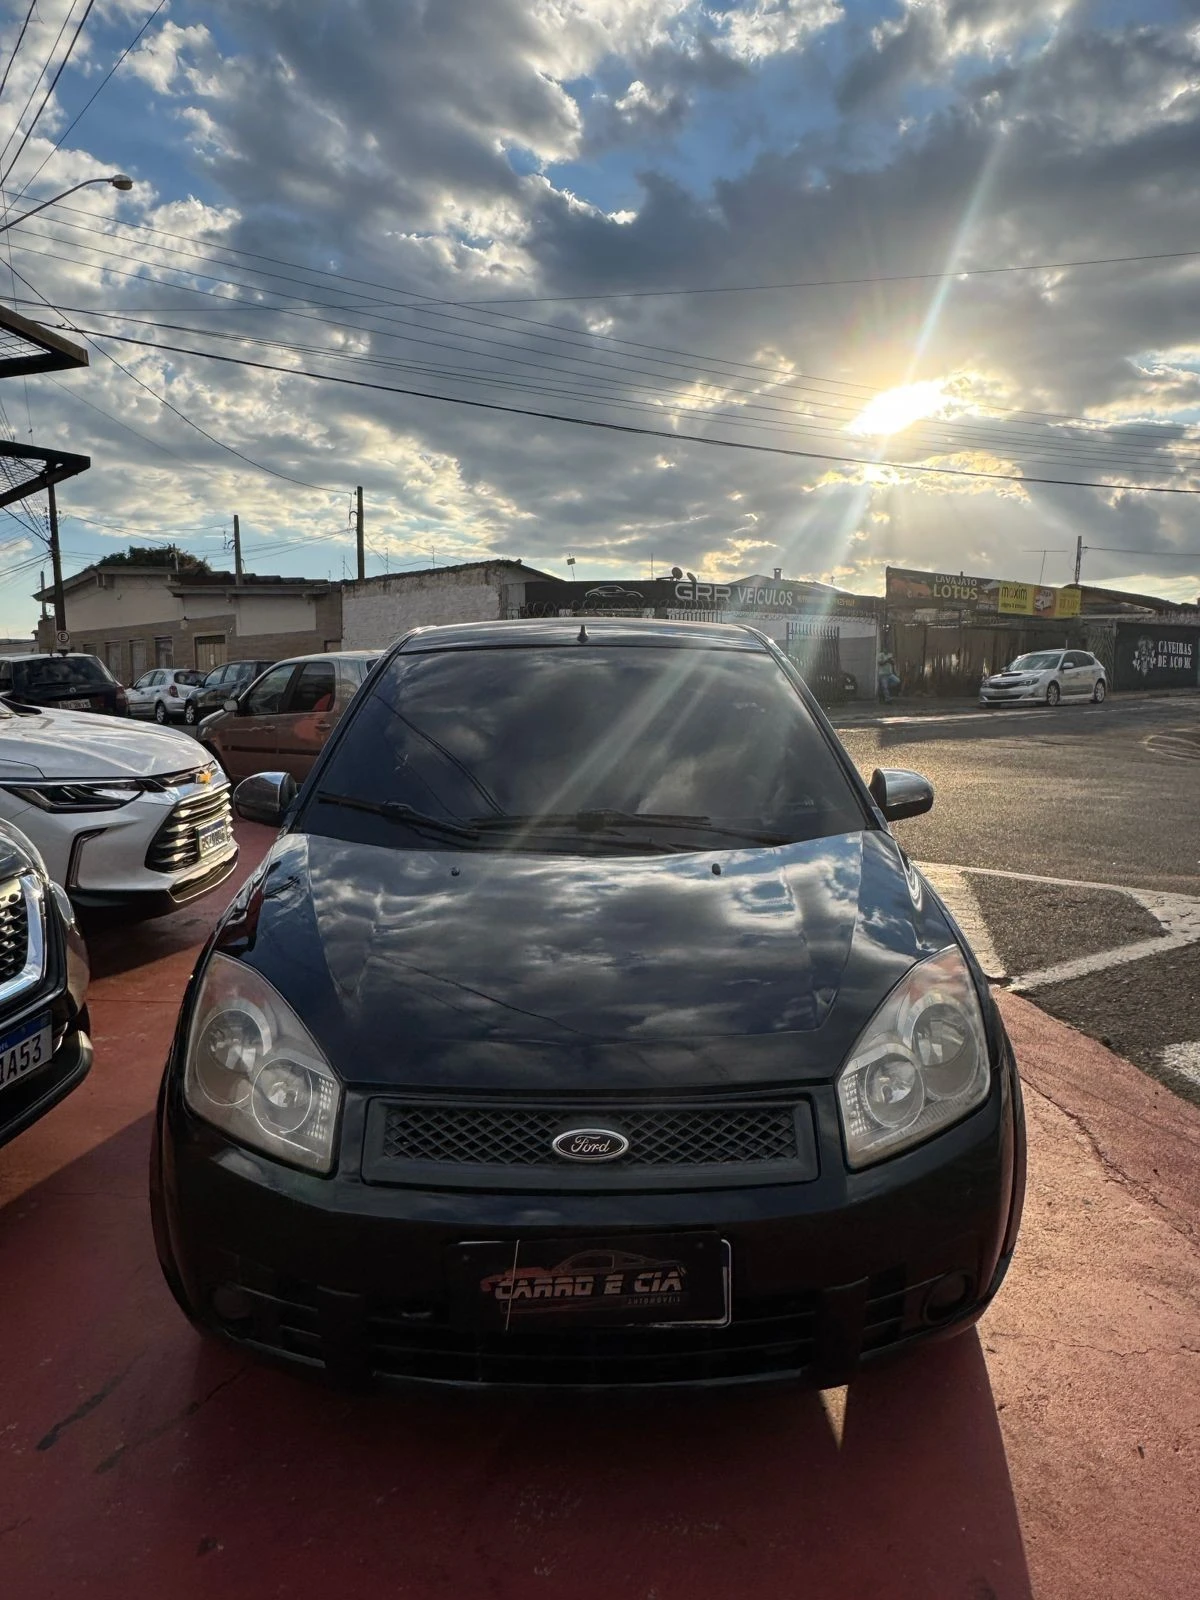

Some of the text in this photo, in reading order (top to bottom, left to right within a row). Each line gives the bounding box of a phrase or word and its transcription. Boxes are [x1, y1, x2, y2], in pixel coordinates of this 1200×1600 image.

[675, 583, 732, 602] GRR
[933, 584, 978, 600] LOTUS
[60, 633, 66, 641] E
[1158, 655, 1167, 667] DE
[571, 1135, 611, 1153] Ford
[495, 1270, 686, 1300] CARRO E CIA
